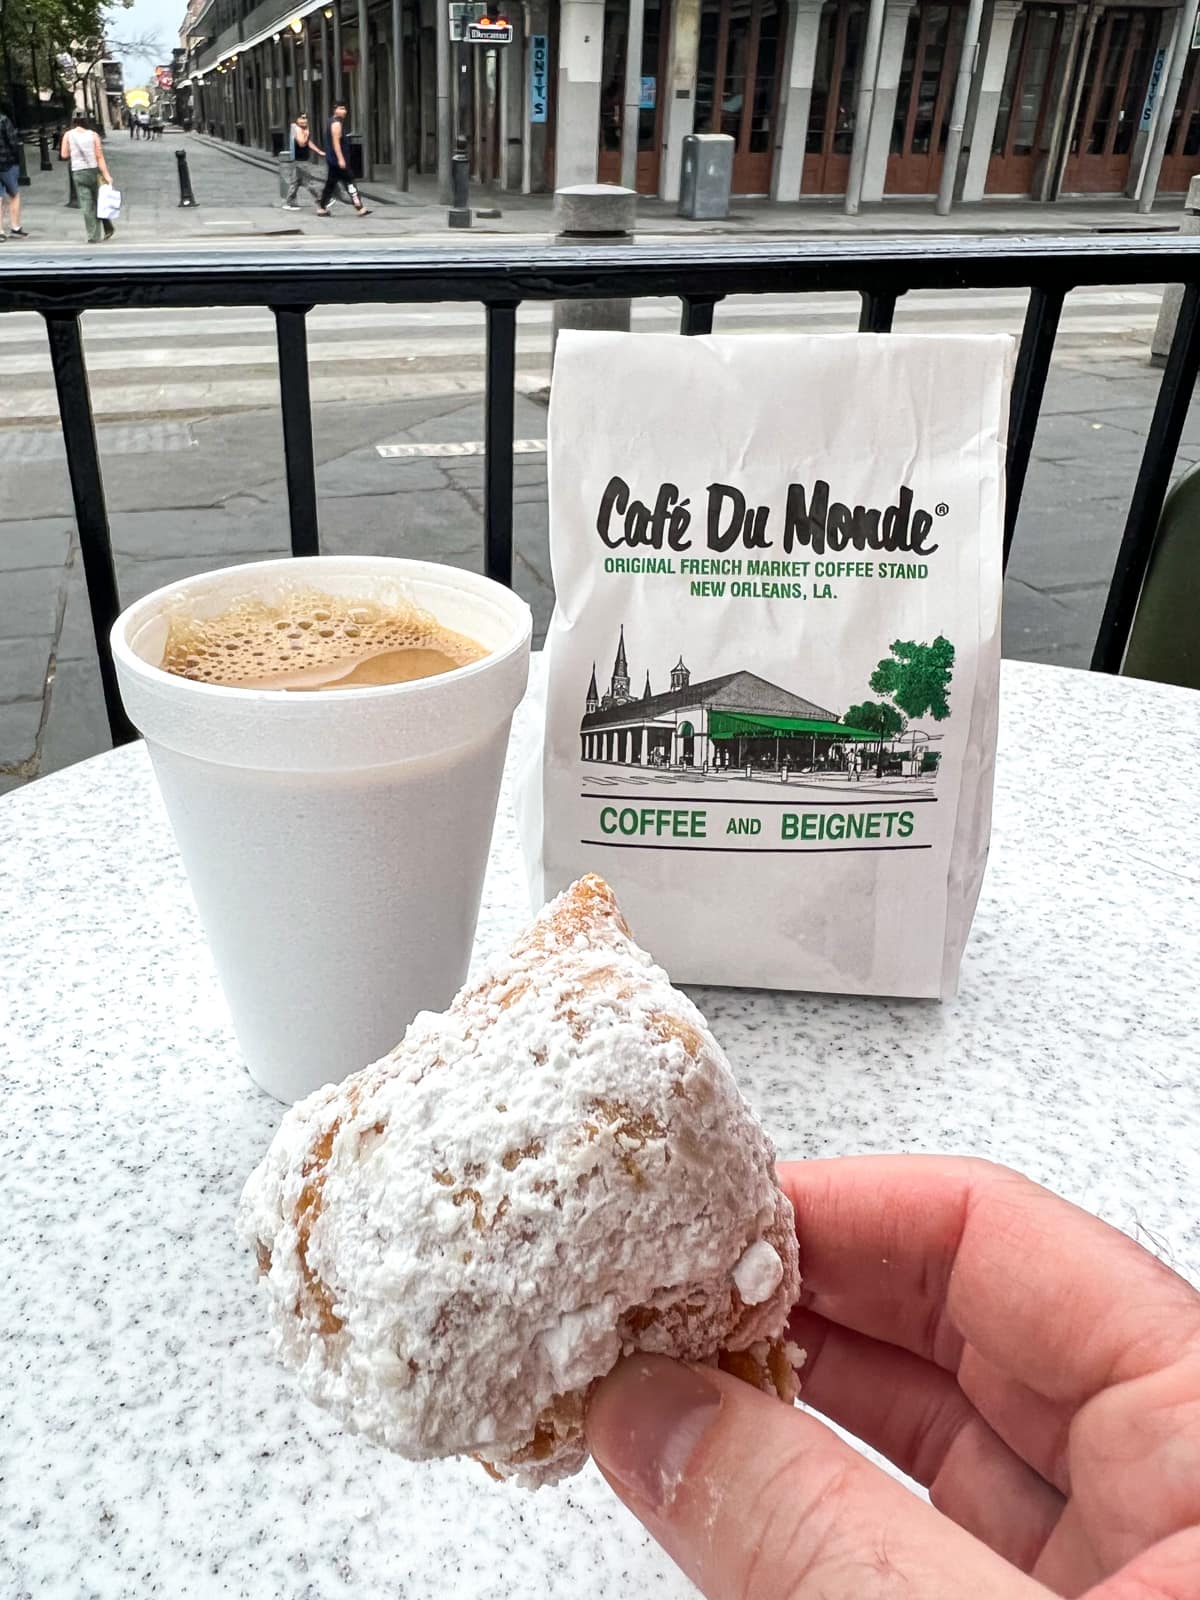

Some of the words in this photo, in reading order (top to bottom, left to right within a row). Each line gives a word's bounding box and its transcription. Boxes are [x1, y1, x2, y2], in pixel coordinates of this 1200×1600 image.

[597, 476, 692, 551] Café
[706, 483, 773, 552] Du
[604, 558, 676, 573] ORIGINAL
[680, 559, 742, 576] FRENCH
[747, 561, 811, 577] MARKET
[814, 561, 874, 578] COFFEE
[878, 563, 929, 579] STAND
[690, 581, 726, 597] NEW
[730, 582, 808, 601] ORLEANS,
[812, 583, 838, 599] LA.
[600, 806, 707, 838] COFFEE
[726, 818, 762, 835] AND
[781, 811, 915, 840] BEIGNETS
